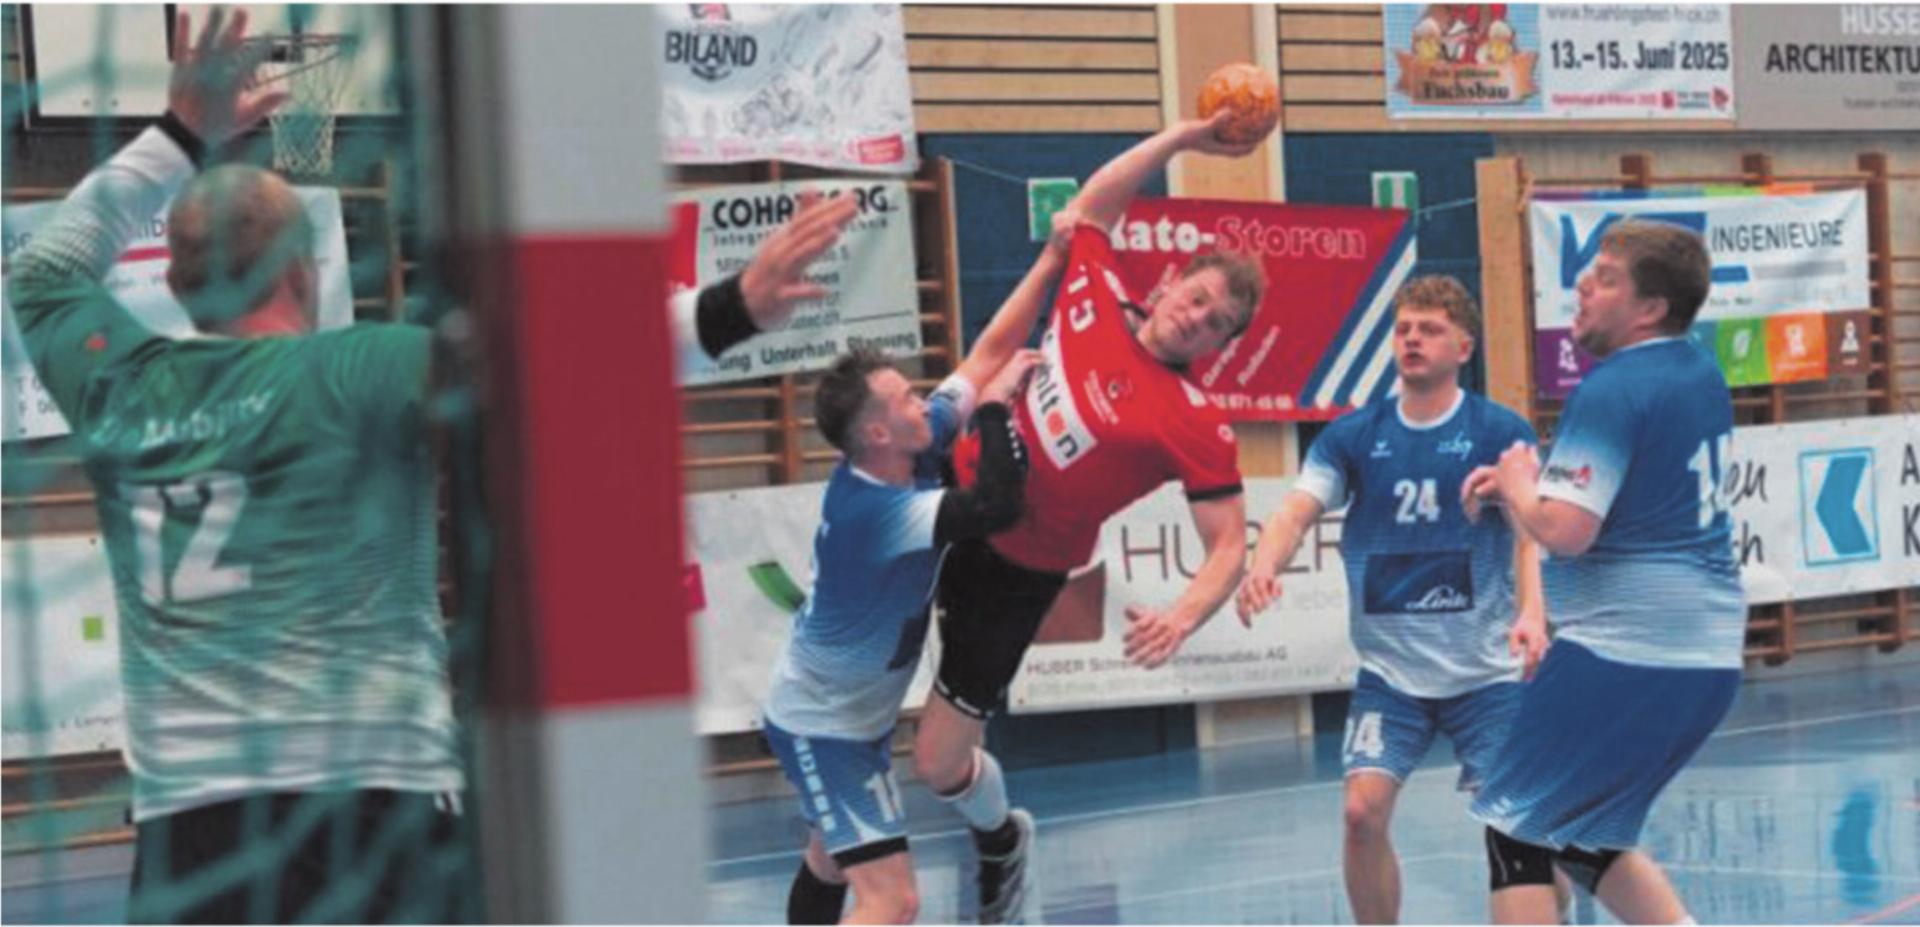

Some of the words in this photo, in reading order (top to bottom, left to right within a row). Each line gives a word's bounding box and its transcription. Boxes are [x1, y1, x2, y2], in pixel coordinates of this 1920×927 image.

[665, 31, 758, 67] BILAND
[1635, 40, 1677, 70] Juni
[1681, 41, 1730, 71] 2025
[1711, 219, 1846, 254] INGENIEURE
[761, 340, 837, 366] Unterhalt
[1393, 479, 1442, 524] 24
[122, 468, 251, 606] 12
[1027, 656, 1084, 676] HUBER
[1267, 647, 1288, 661] AG
